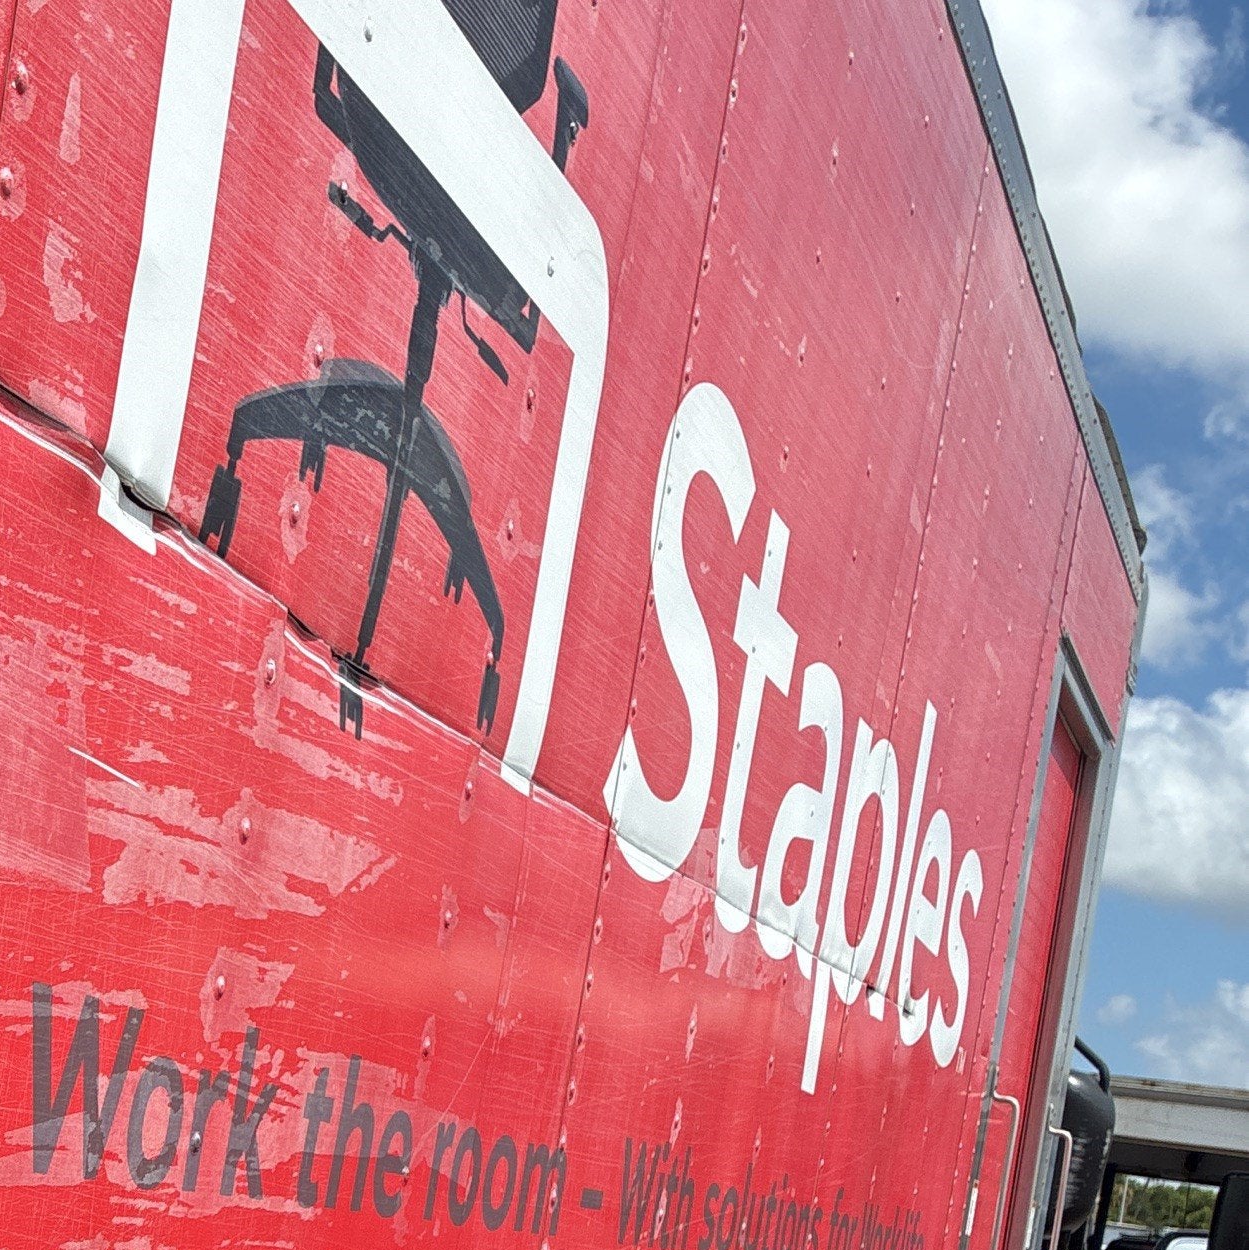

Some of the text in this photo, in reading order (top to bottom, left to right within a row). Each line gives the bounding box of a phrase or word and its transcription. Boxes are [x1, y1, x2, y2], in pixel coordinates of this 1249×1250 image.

[602, 382, 983, 1095] Staples
[32, 981, 281, 1200] Work
[295, 1055, 413, 1218] the
[423, 1119, 568, 1237] room
